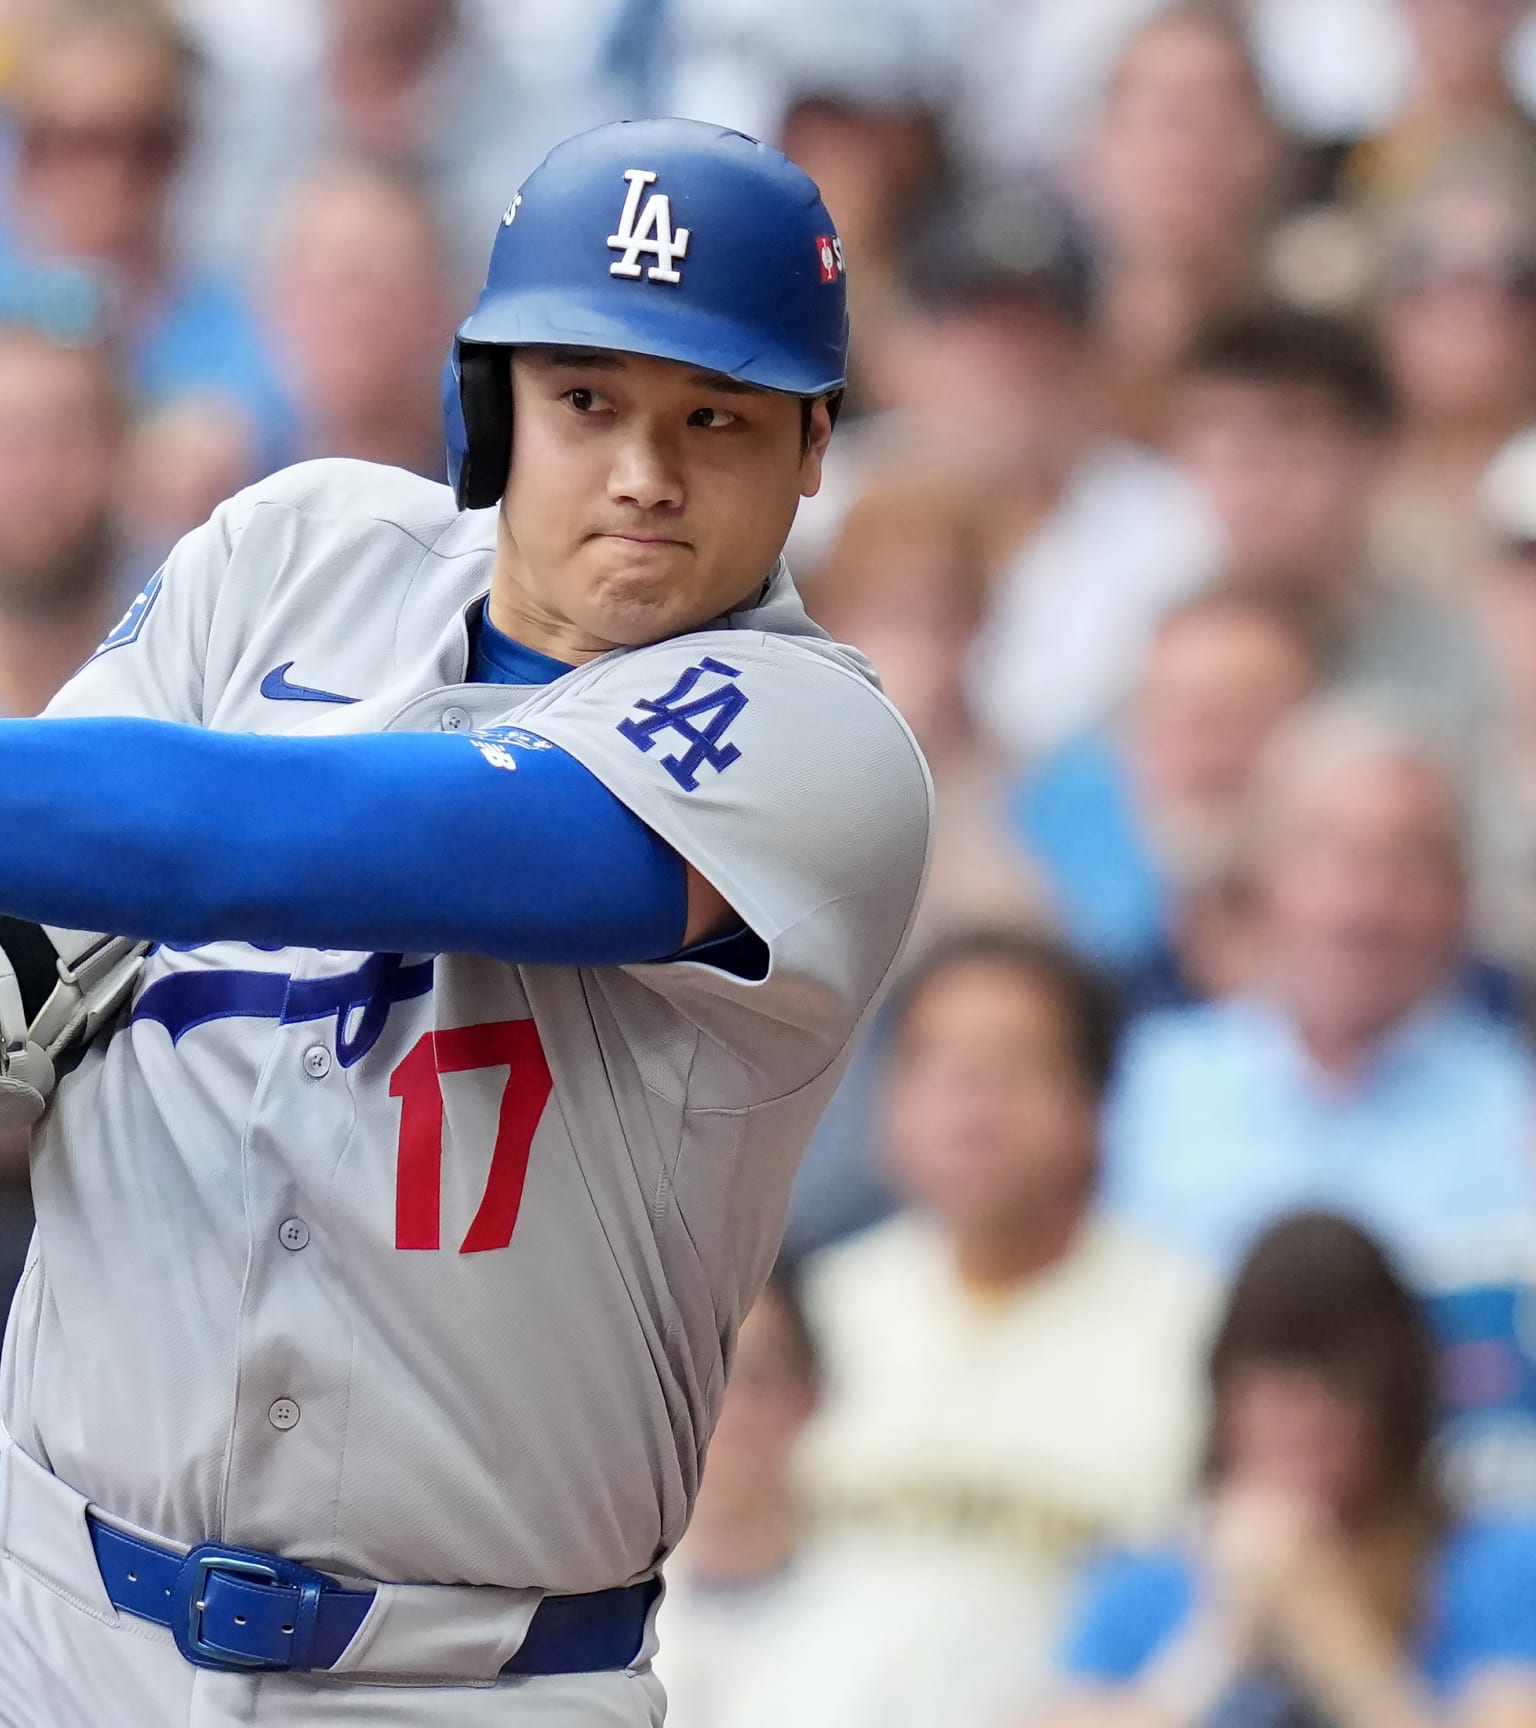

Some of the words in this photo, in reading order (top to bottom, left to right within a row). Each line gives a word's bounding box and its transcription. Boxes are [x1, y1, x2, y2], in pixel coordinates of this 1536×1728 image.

[607, 168, 690, 284] LA
[615, 656, 749, 792] LA
[388, 1018, 553, 1254] 17
